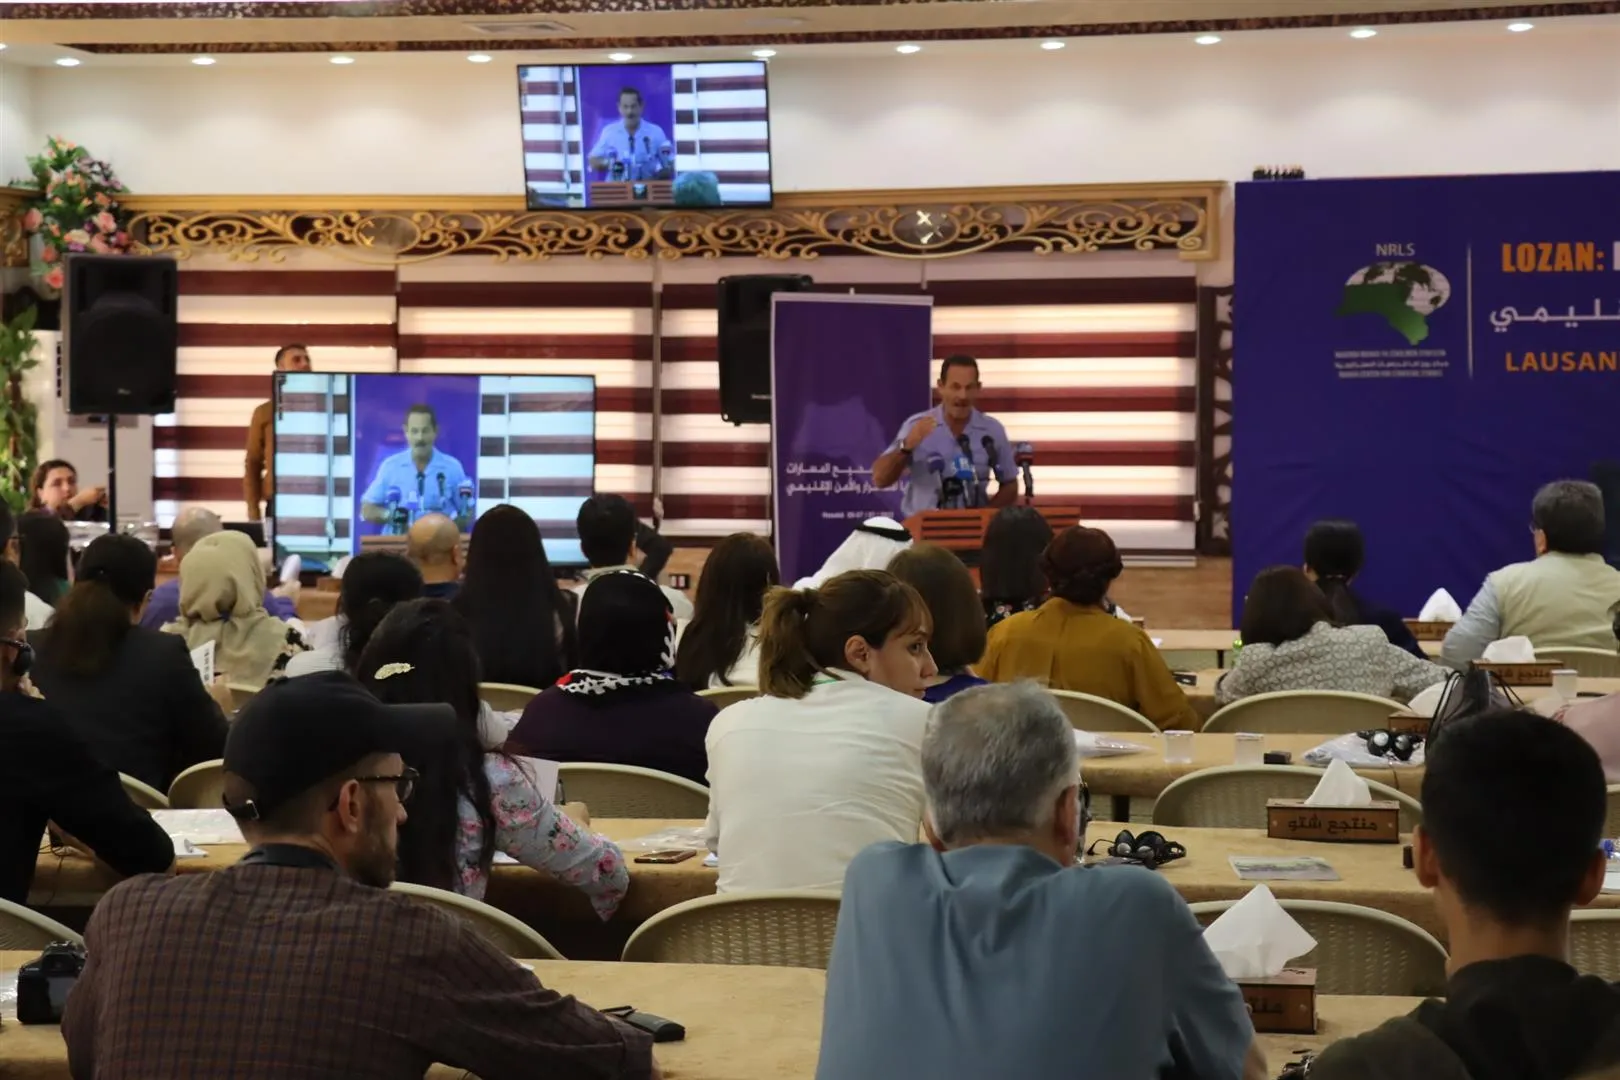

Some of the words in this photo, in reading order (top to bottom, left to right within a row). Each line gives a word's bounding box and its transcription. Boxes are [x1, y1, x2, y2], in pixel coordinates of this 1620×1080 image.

[1376, 243, 1415, 256] NRLS
[1502, 241, 1605, 272] LOZAN:
[1490, 298, 1620, 332] ليمي
[1505, 351, 1620, 372] LAUSAN
[1327, 817, 1378, 834] منتجع
